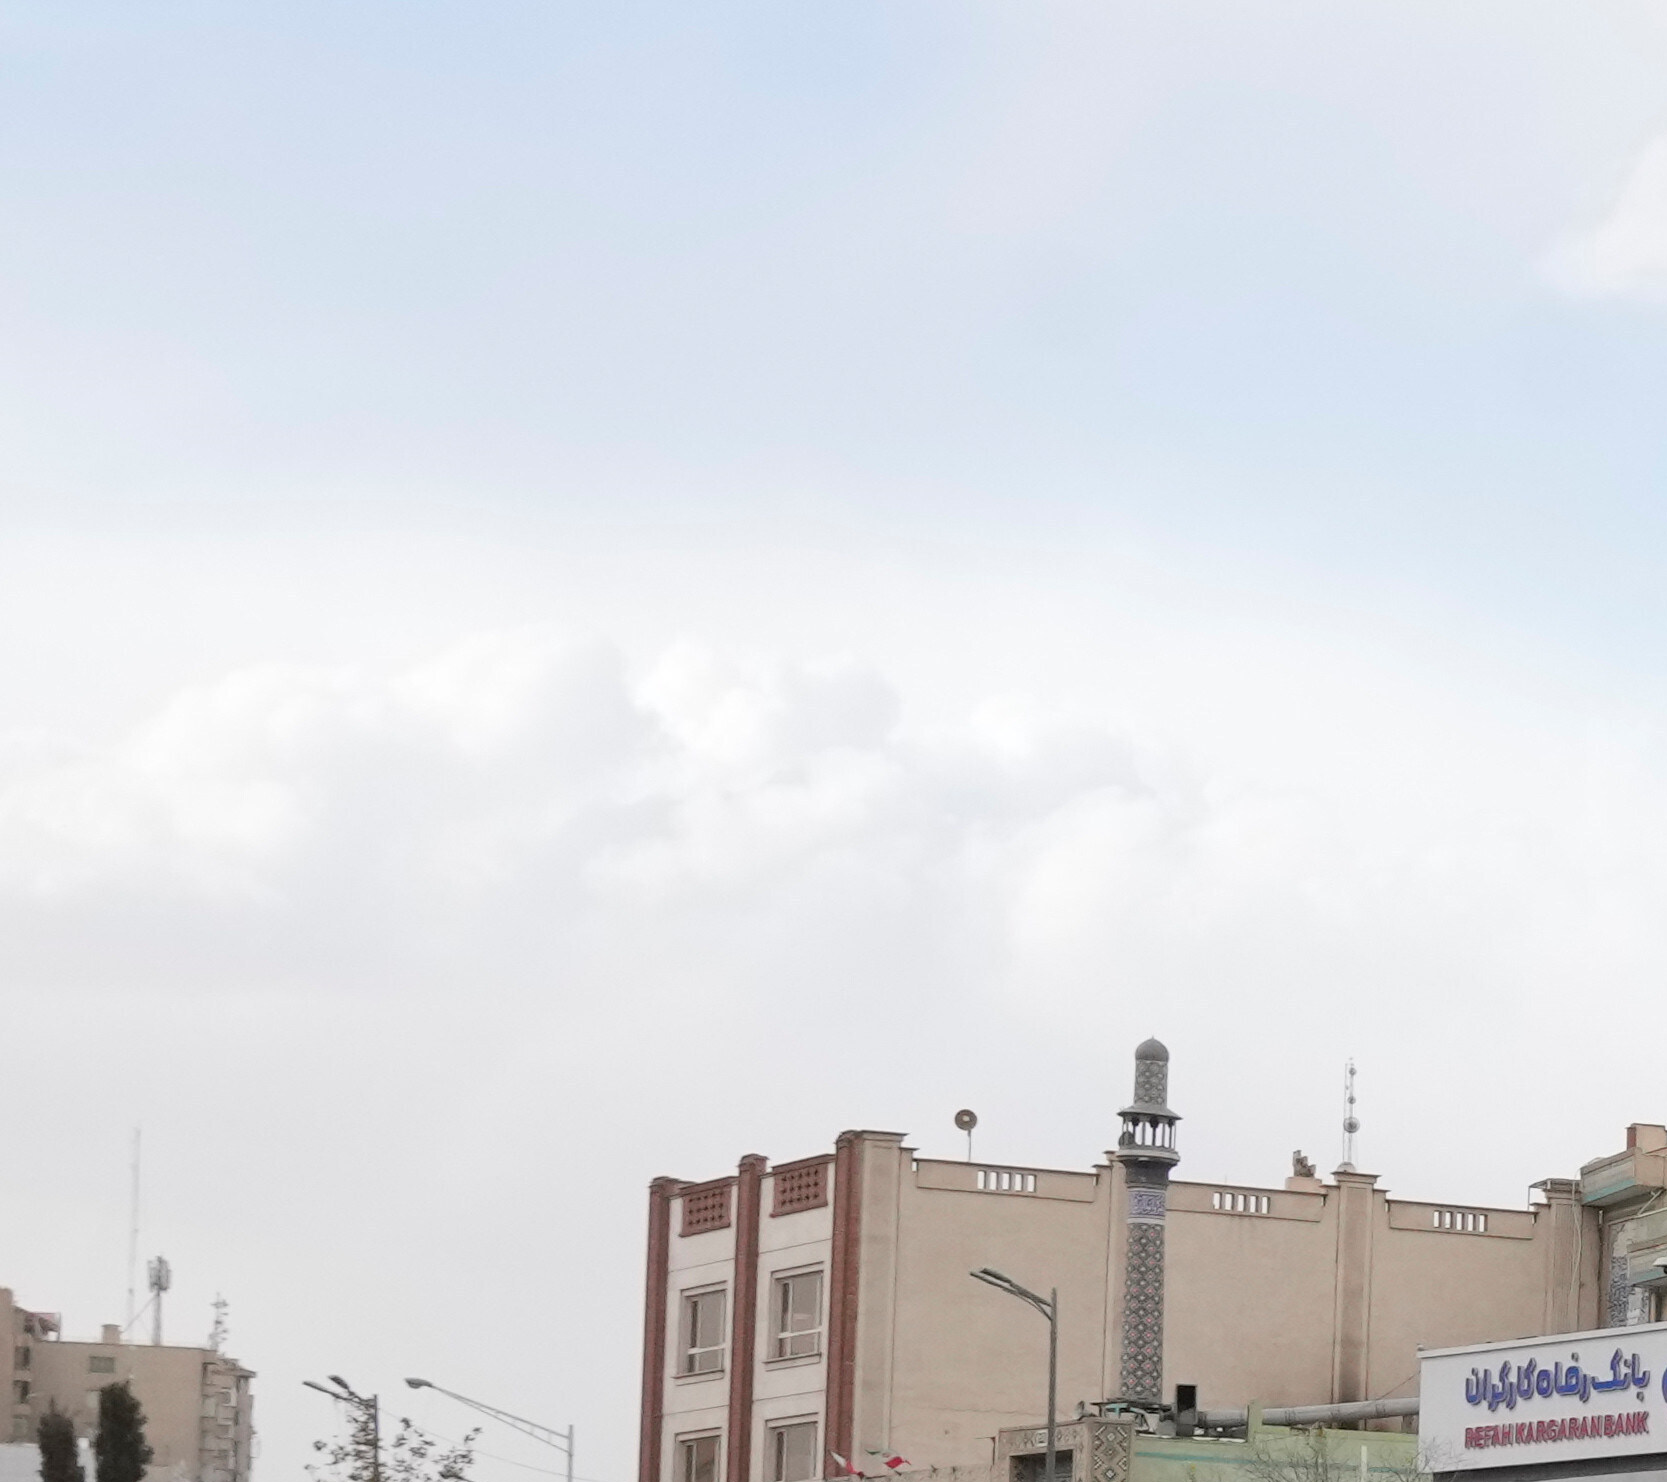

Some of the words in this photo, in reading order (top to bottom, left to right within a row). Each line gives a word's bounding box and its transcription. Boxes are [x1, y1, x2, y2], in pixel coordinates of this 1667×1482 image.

[1465, 1358, 1537, 1412] کارگران
[1536, 1352, 1591, 1403] رفاه
[1591, 1348, 1650, 1403] بانک
[1465, 1423, 1514, 1449] REFAH
[1515, 1415, 1602, 1445] KARGARAN
[1603, 1411, 1649, 1438] BANK
